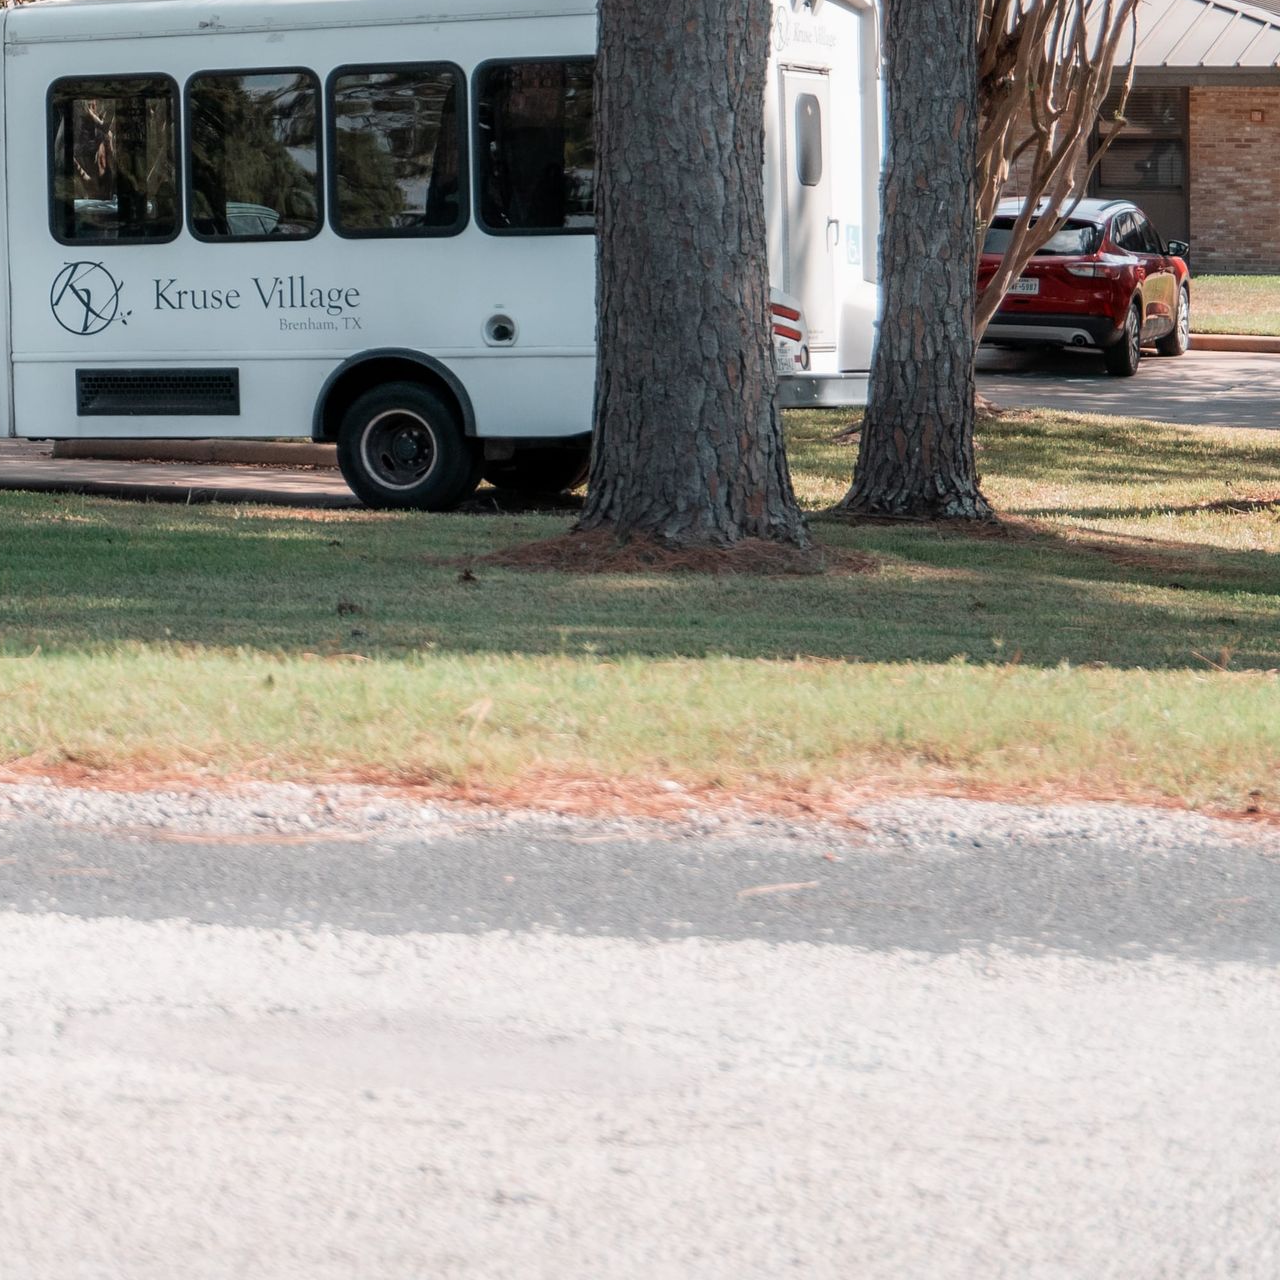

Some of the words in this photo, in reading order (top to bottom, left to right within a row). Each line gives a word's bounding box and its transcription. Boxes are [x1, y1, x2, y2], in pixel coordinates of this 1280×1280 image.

[151, 278, 241, 310] Kruse
[250, 275, 361, 316] Village
[279, 318, 338, 331] Brenham,
[341, 317, 362, 330] TX
